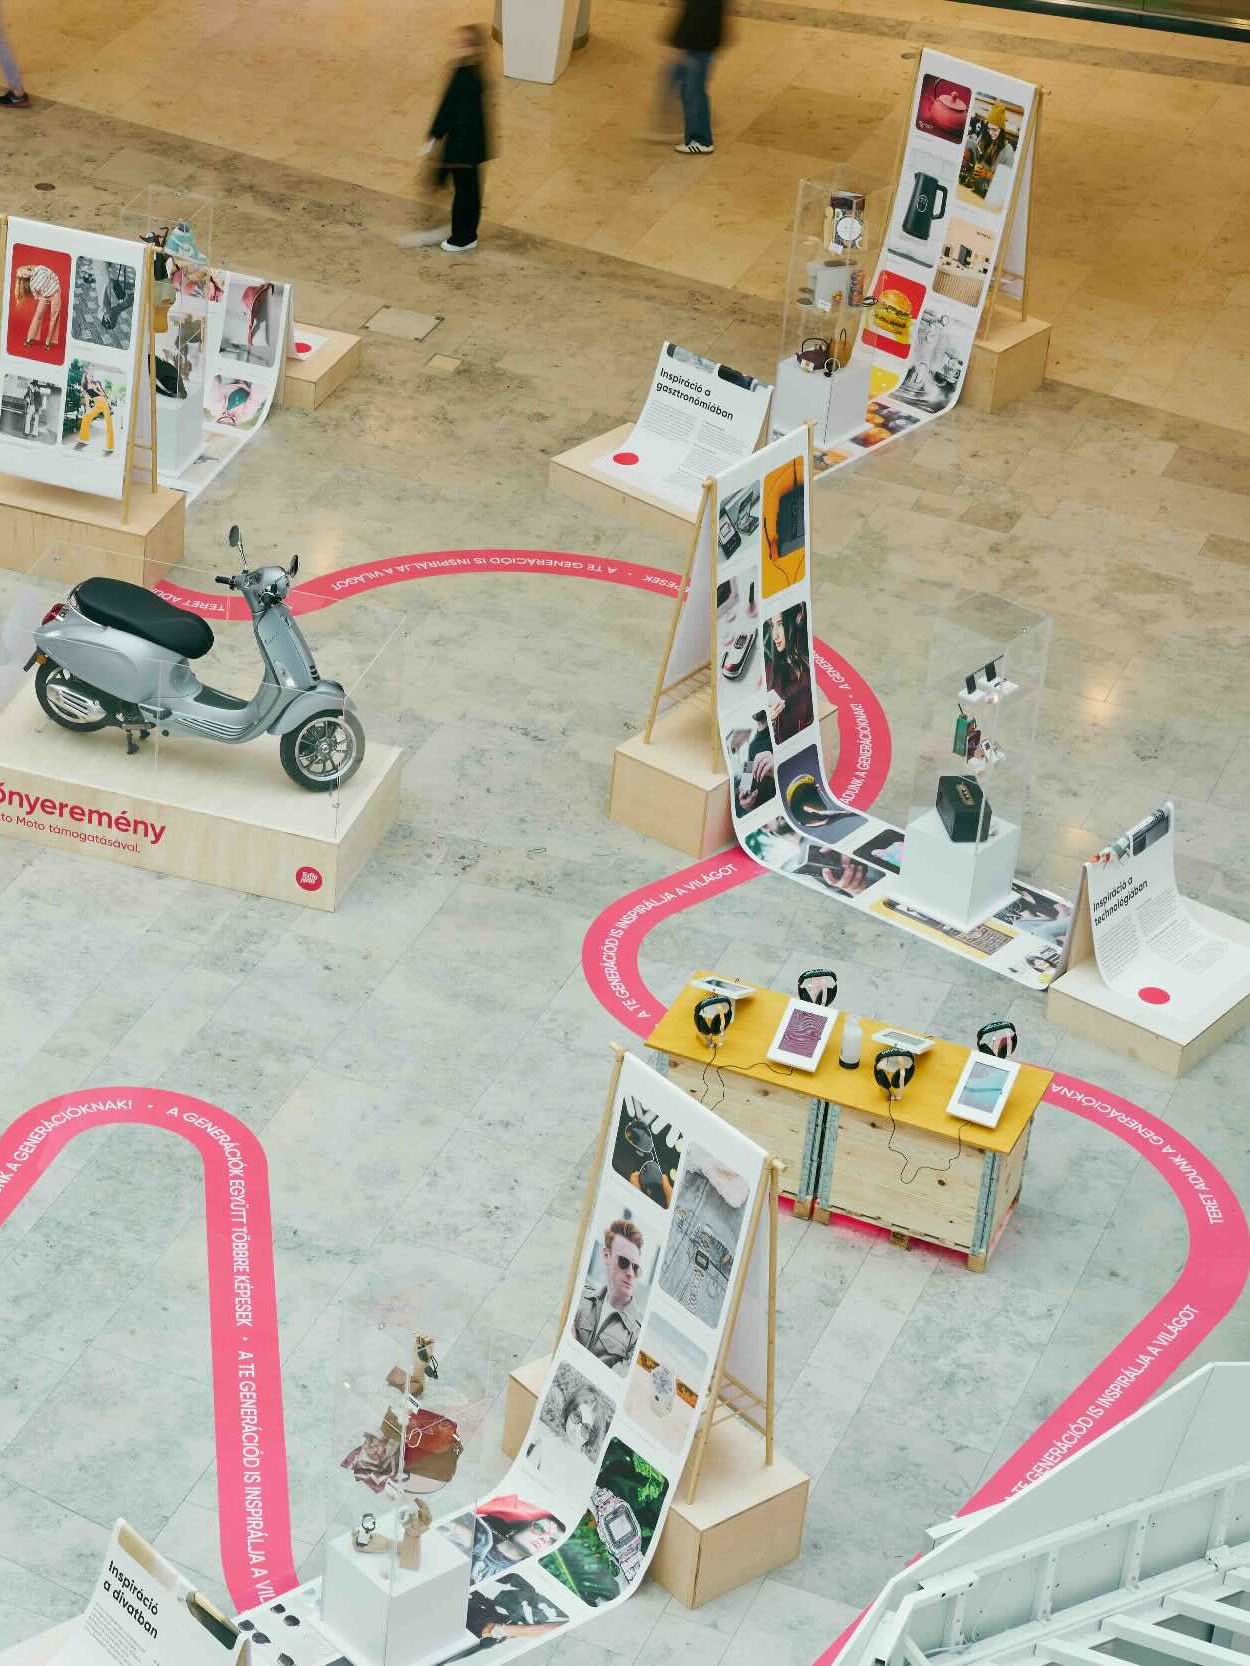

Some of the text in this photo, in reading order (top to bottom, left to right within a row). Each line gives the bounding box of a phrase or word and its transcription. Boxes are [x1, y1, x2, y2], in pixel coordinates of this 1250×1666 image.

[659, 367, 712, 397] Inspiráció a
[656, 382, 734, 421] gasztronómiában
[395, 558, 471, 573] INSPIRÁLJA
[473, 557, 487, 565] IS
[491, 557, 584, 569] GENERÁCIÓD
[586, 563, 602, 572] TE
[330, 570, 384, 591] VILÁGOT
[181, 599, 225, 612] TERET
[16, 815, 46, 831] Moto
[48, 823, 141, 854] támogatásával.
[1093, 876, 1134, 912] Inspiráció a
[1094, 879, 1148, 927] technológiában
[600, 862, 739, 1018] A TE GENERÁCIÓD IS INSPIRÁLJA A VILÁGOT
[13, 1099, 133, 1162] GENERÁCIÓKNAK!
[5, 1161, 23, 1172] A
[1051, 1082, 1224, 1225] TERET ADUNK A GENERÁCIÓKNA
[166, 1106, 254, 1328] A GENERÁCIÓK EGYÜTT TÖBBRE KÉPESEK
[1152, 1303, 1199, 1347] VILÁGOT
[237, 1350, 254, 1360] A
[1146, 1345, 1164, 1357] A
[238, 1362, 255, 1378] TE
[1095, 1354, 1156, 1409] INSPIRÁLJA
[239, 1381, 264, 1469] GENERÁCIÓD
[1085, 1405, 1105, 1419] IS
[243, 1470, 261, 1484] IS
[245, 1486, 269, 1565] INSPIRÁLJA
[108, 1559, 159, 1616] Inspiráció
[250, 1567, 269, 1579] A
[103, 1580, 111, 1592] a
[112, 1589, 158, 1639] divatban
